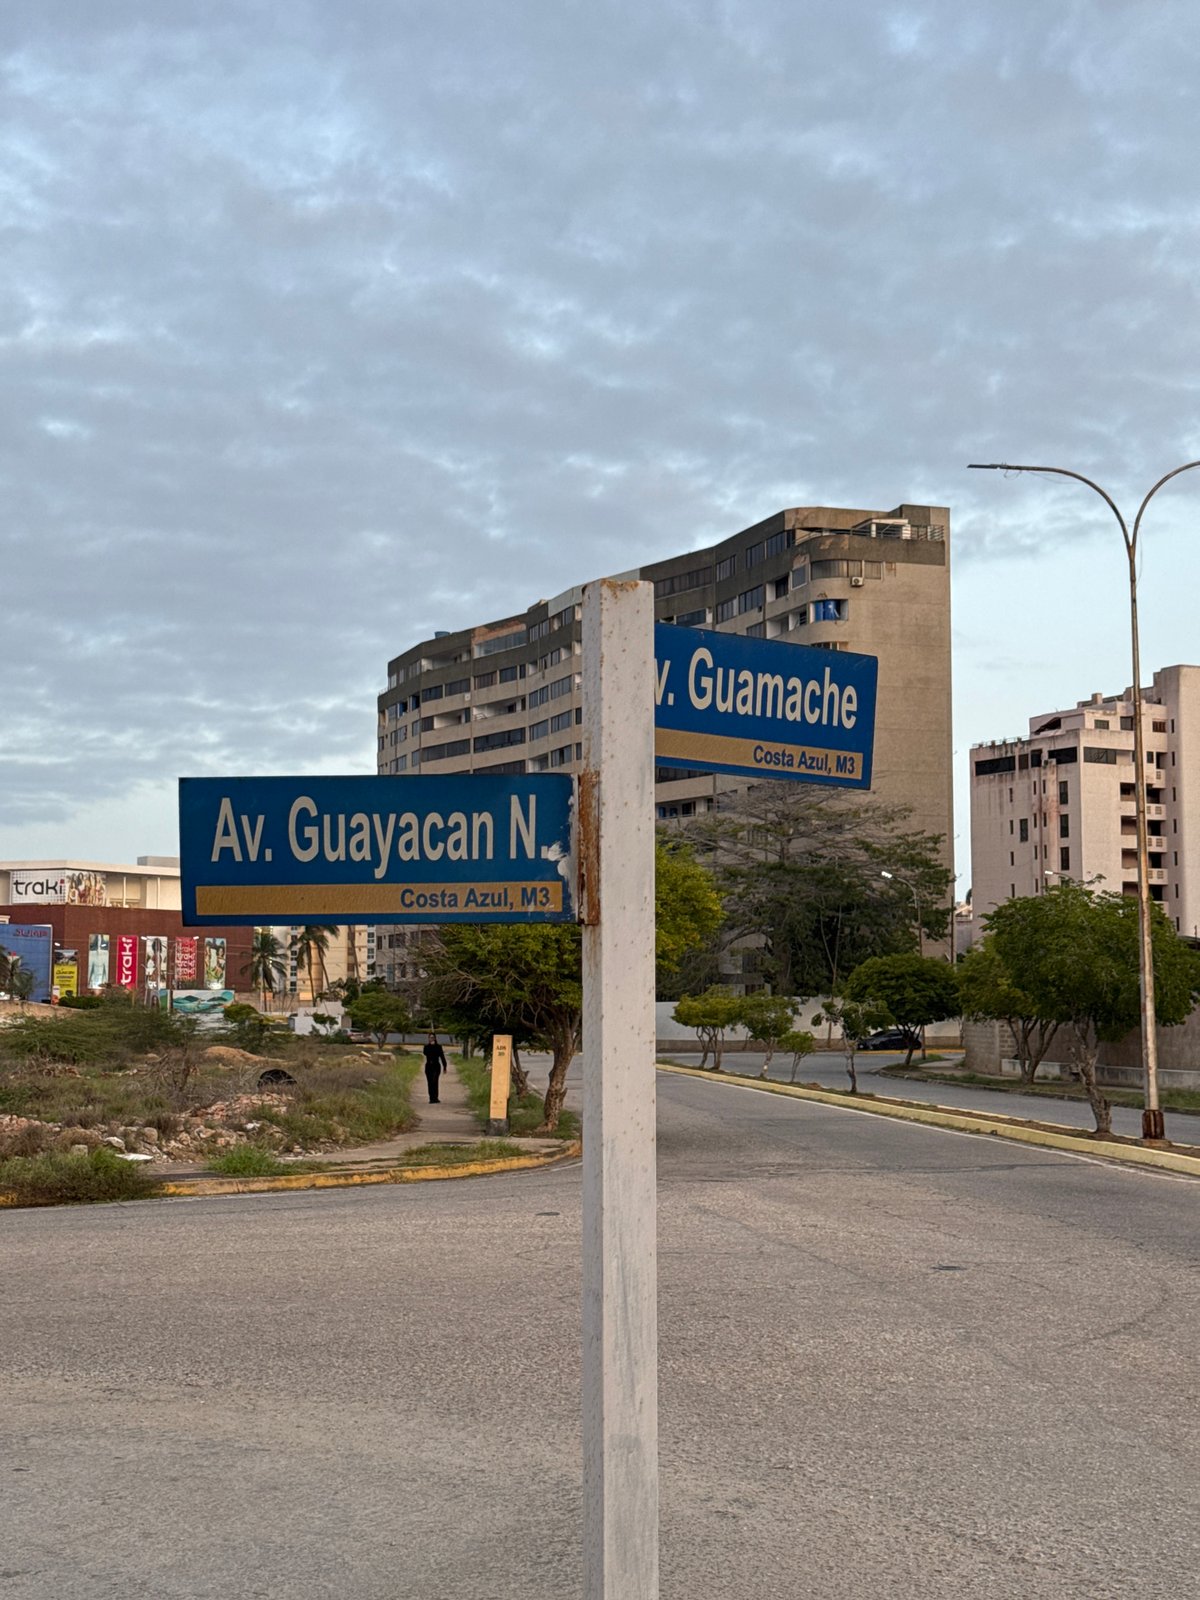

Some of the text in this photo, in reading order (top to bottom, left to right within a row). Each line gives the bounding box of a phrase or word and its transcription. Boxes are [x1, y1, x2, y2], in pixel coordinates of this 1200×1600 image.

[688, 647, 858, 729] Guamache
[753, 745, 855, 775] Costa Azul, M3
[211, 794, 549, 880] Av. Guayacan N.
[12, 878, 65, 896] traki
[400, 887, 550, 911] Costa Azul, M3
[120, 937, 133, 986] traki
